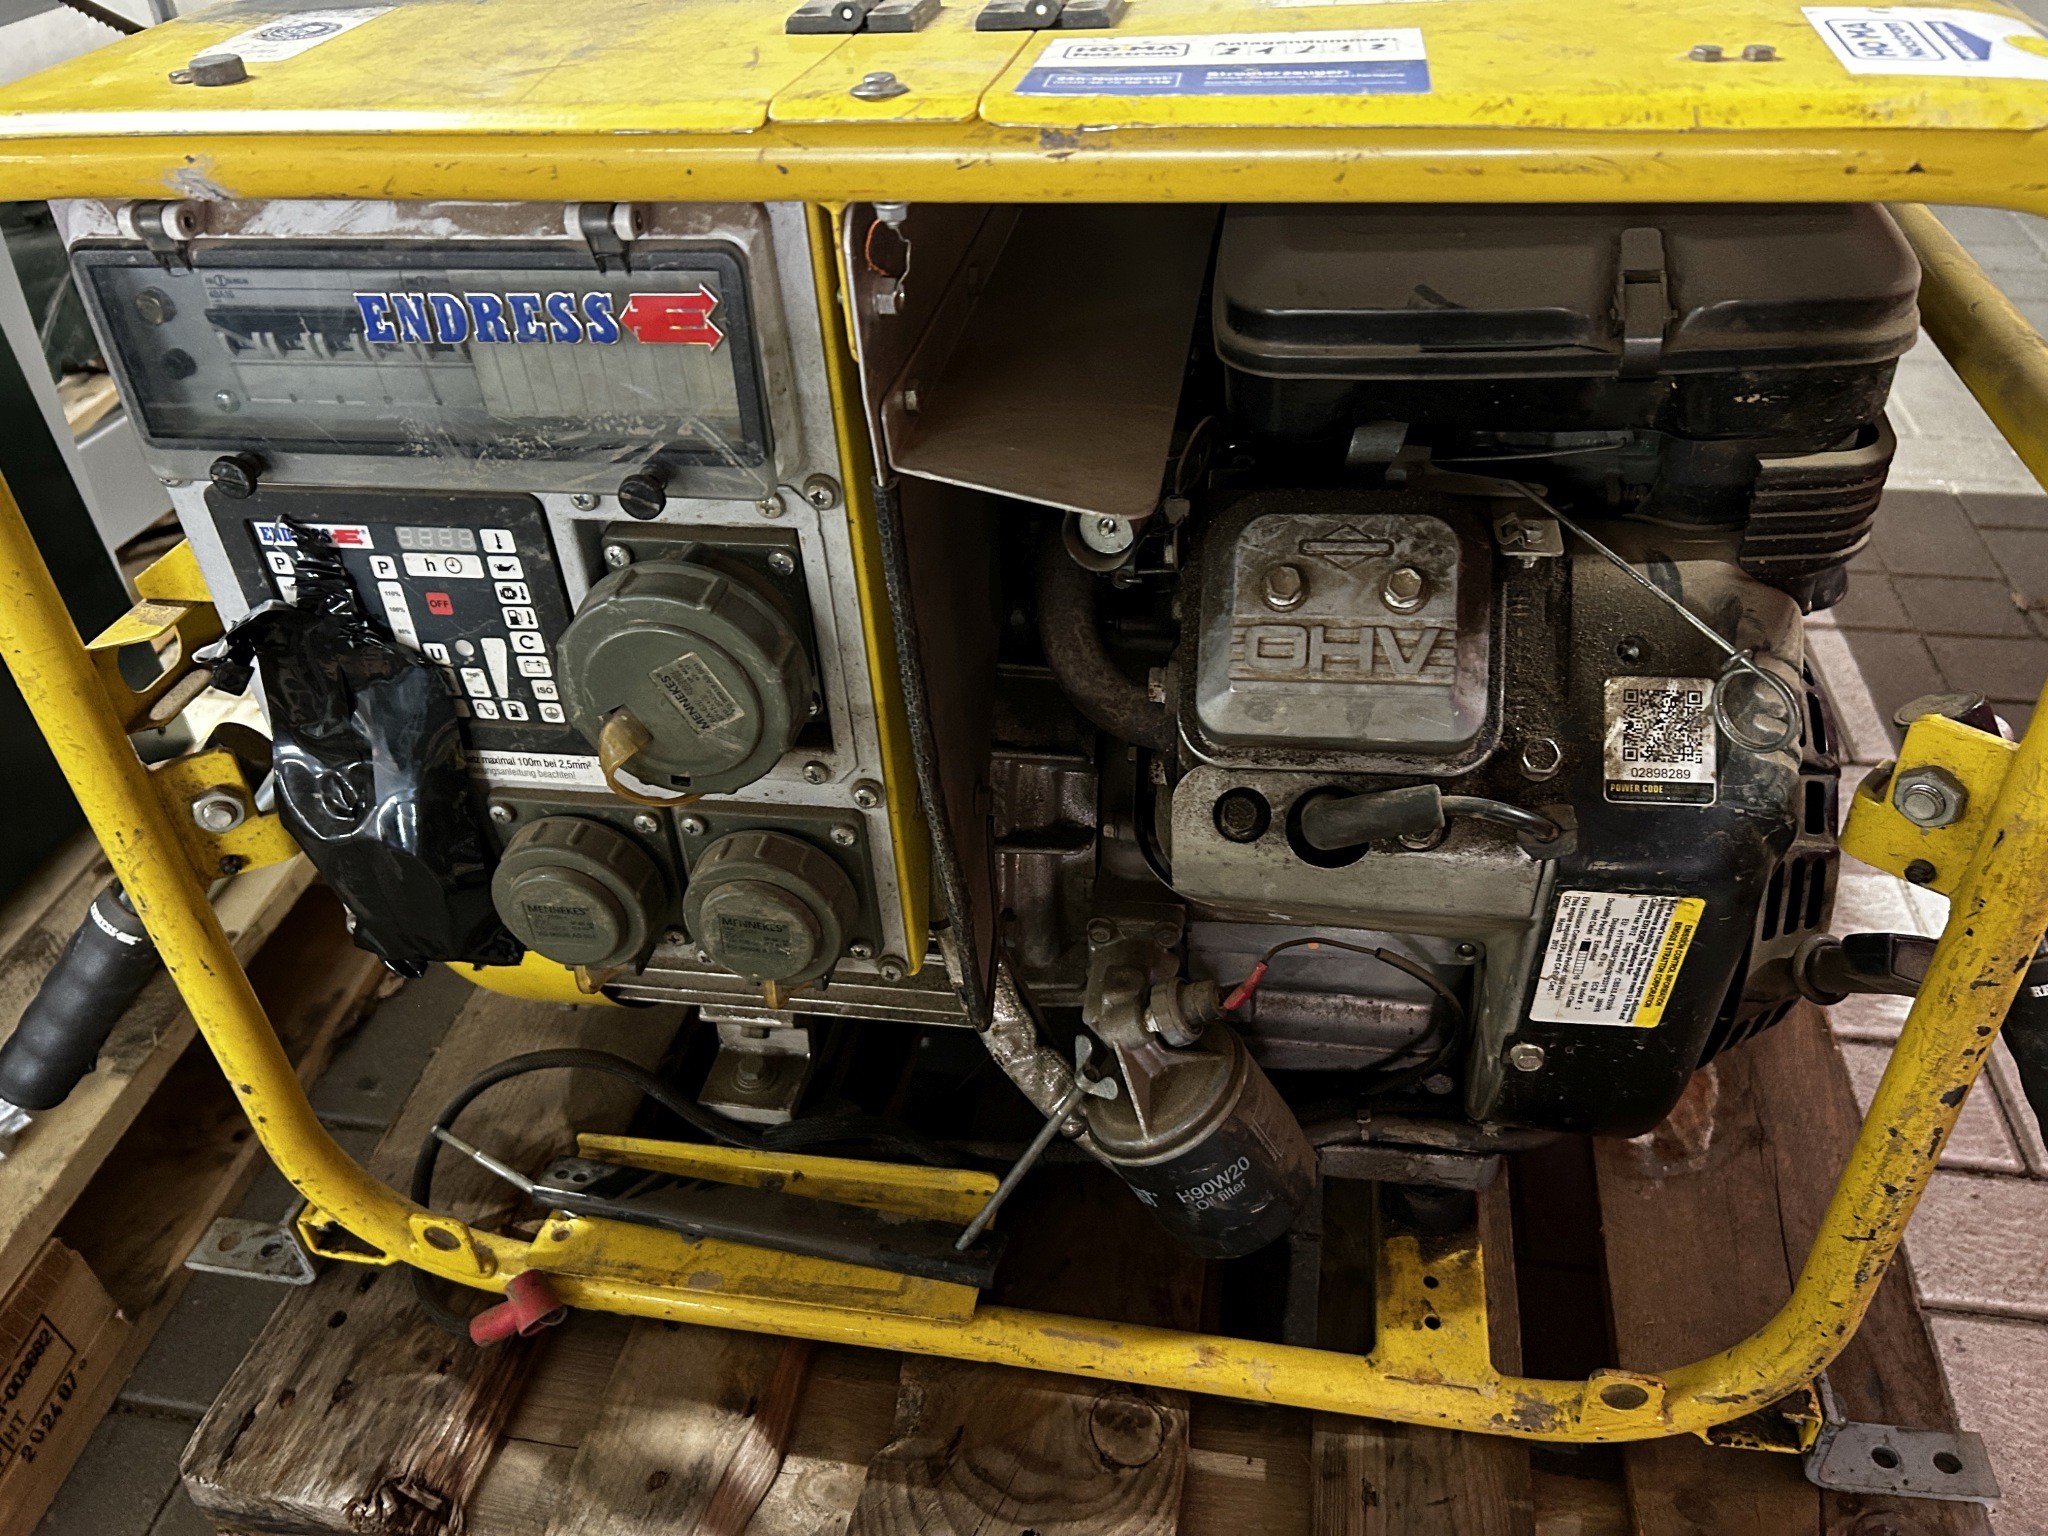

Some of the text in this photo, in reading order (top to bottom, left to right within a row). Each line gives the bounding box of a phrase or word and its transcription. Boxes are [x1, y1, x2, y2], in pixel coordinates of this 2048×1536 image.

[353, 292, 620, 344] ENDRESS
[275, 557, 285, 570] P
[378, 562, 389, 574] P
[424, 558, 436, 571] h
[430, 600, 450, 608] OFF
[430, 648, 442, 660] U
[1245, 624, 1441, 676] OHV
[482, 756, 516, 766] maximal
[518, 757, 543, 767] 100m
[544, 758, 557, 768] bei
[1631, 767, 1690, 778] 02898289
[1610, 783, 1639, 792] POWER
[1642, 784, 1663, 793] CODE
[1668, 921, 1681, 941] BRIGGS
[1654, 924, 1692, 1006] EMISSION CONTROL INFORMATION
[1656, 947, 1672, 972] STRATTON
[1643, 973, 1662, 1007] CORPORATION
[1219, 1178, 1247, 1202] filter
